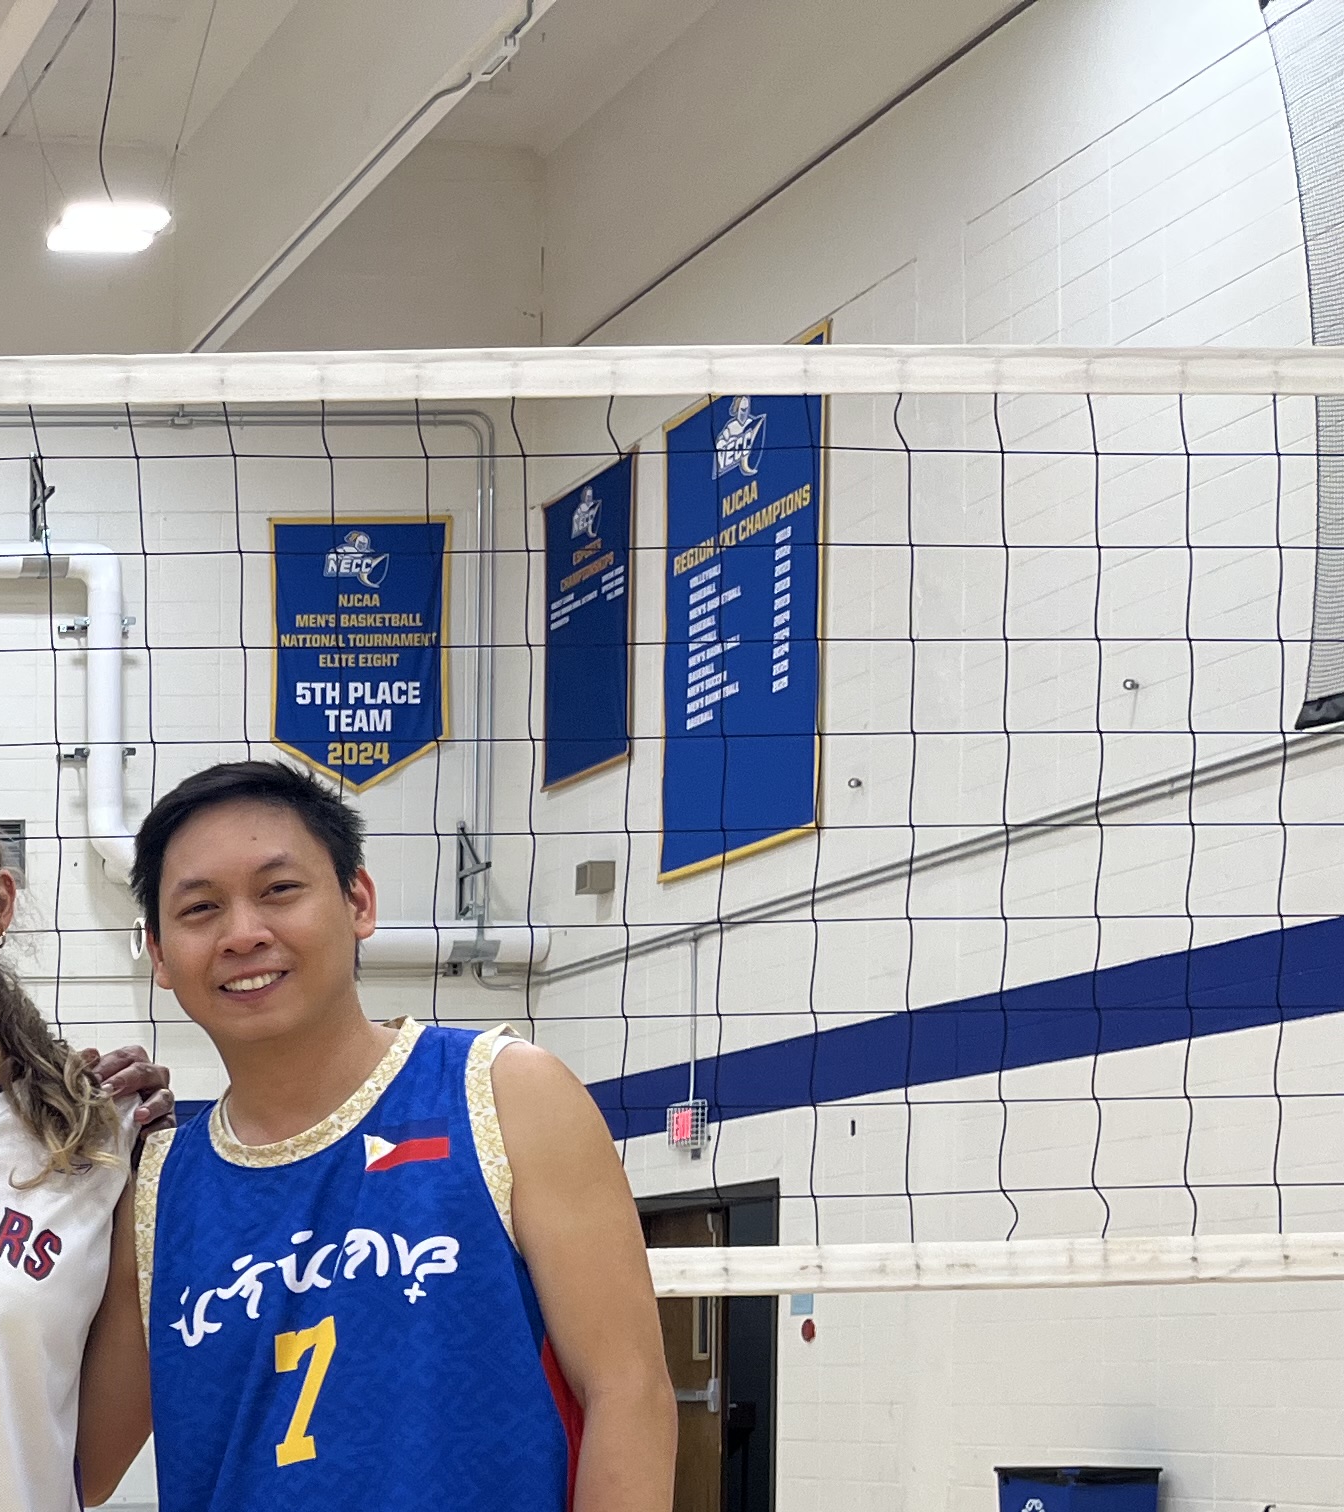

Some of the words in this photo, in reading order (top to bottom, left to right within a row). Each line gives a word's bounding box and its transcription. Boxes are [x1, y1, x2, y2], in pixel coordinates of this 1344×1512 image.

[722, 481, 758, 518] NJCAA
[674, 537, 714, 577] REGION
[739, 484, 811, 542] CHAMPIONS
[327, 558, 373, 573] NECC
[338, 593, 380, 607] NJCAA
[295, 614, 336, 628] MEN'S
[340, 613, 423, 627] BASKETBALL
[281, 634, 345, 648] NATIONAL
[348, 633, 437, 648] TOURNAMENT
[319, 654, 356, 668] ELITE
[358, 653, 400, 667] EIGHT
[295, 681, 340, 705] 5TH
[348, 681, 421, 704] PLACE
[325, 709, 392, 733] TEAM
[328, 742, 390, 765] 2024
[275, 1315, 337, 1467] 7
